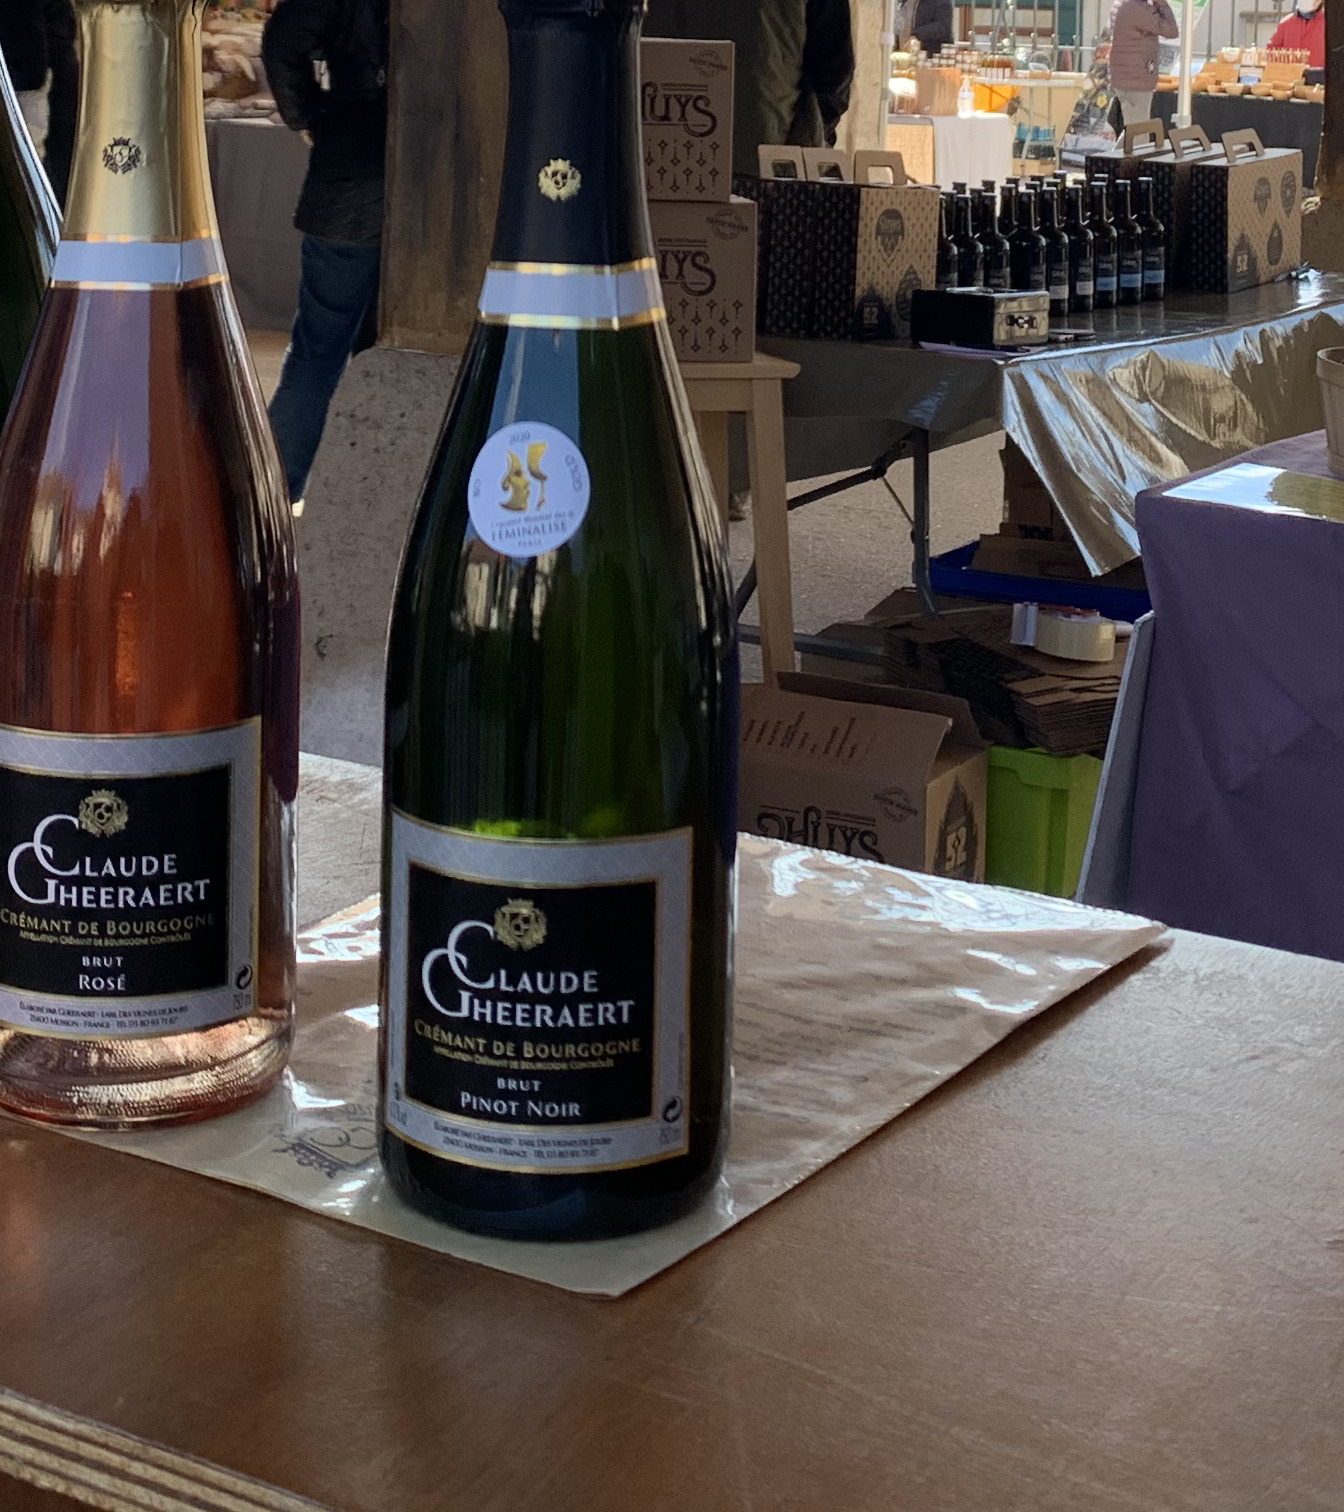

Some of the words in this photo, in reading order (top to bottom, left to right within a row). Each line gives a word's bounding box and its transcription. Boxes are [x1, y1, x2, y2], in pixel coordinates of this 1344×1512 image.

[34, 814, 177, 877] CLAUDE
[7, 842, 210, 908] GHEERAERT
[0, 908, 71, 934] CRÉMANT
[78, 921, 99, 935] DE
[107, 913, 215, 936] BOURGOGNE
[82, 956, 124, 968] BRUT
[448, 920, 599, 994] CLAUDE
[79, 972, 126, 991] ROSÉ
[422, 948, 635, 1028] GHEERAERT
[414, 1019, 487, 1053] CRÉMANT
[492, 1041, 516, 1057] DE
[522, 1038, 641, 1059] BOURGOGNE
[496, 1076, 541, 1091] BRUT
[460, 1091, 519, 1117] PINOT
[527, 1099, 581, 1118] NOIR
